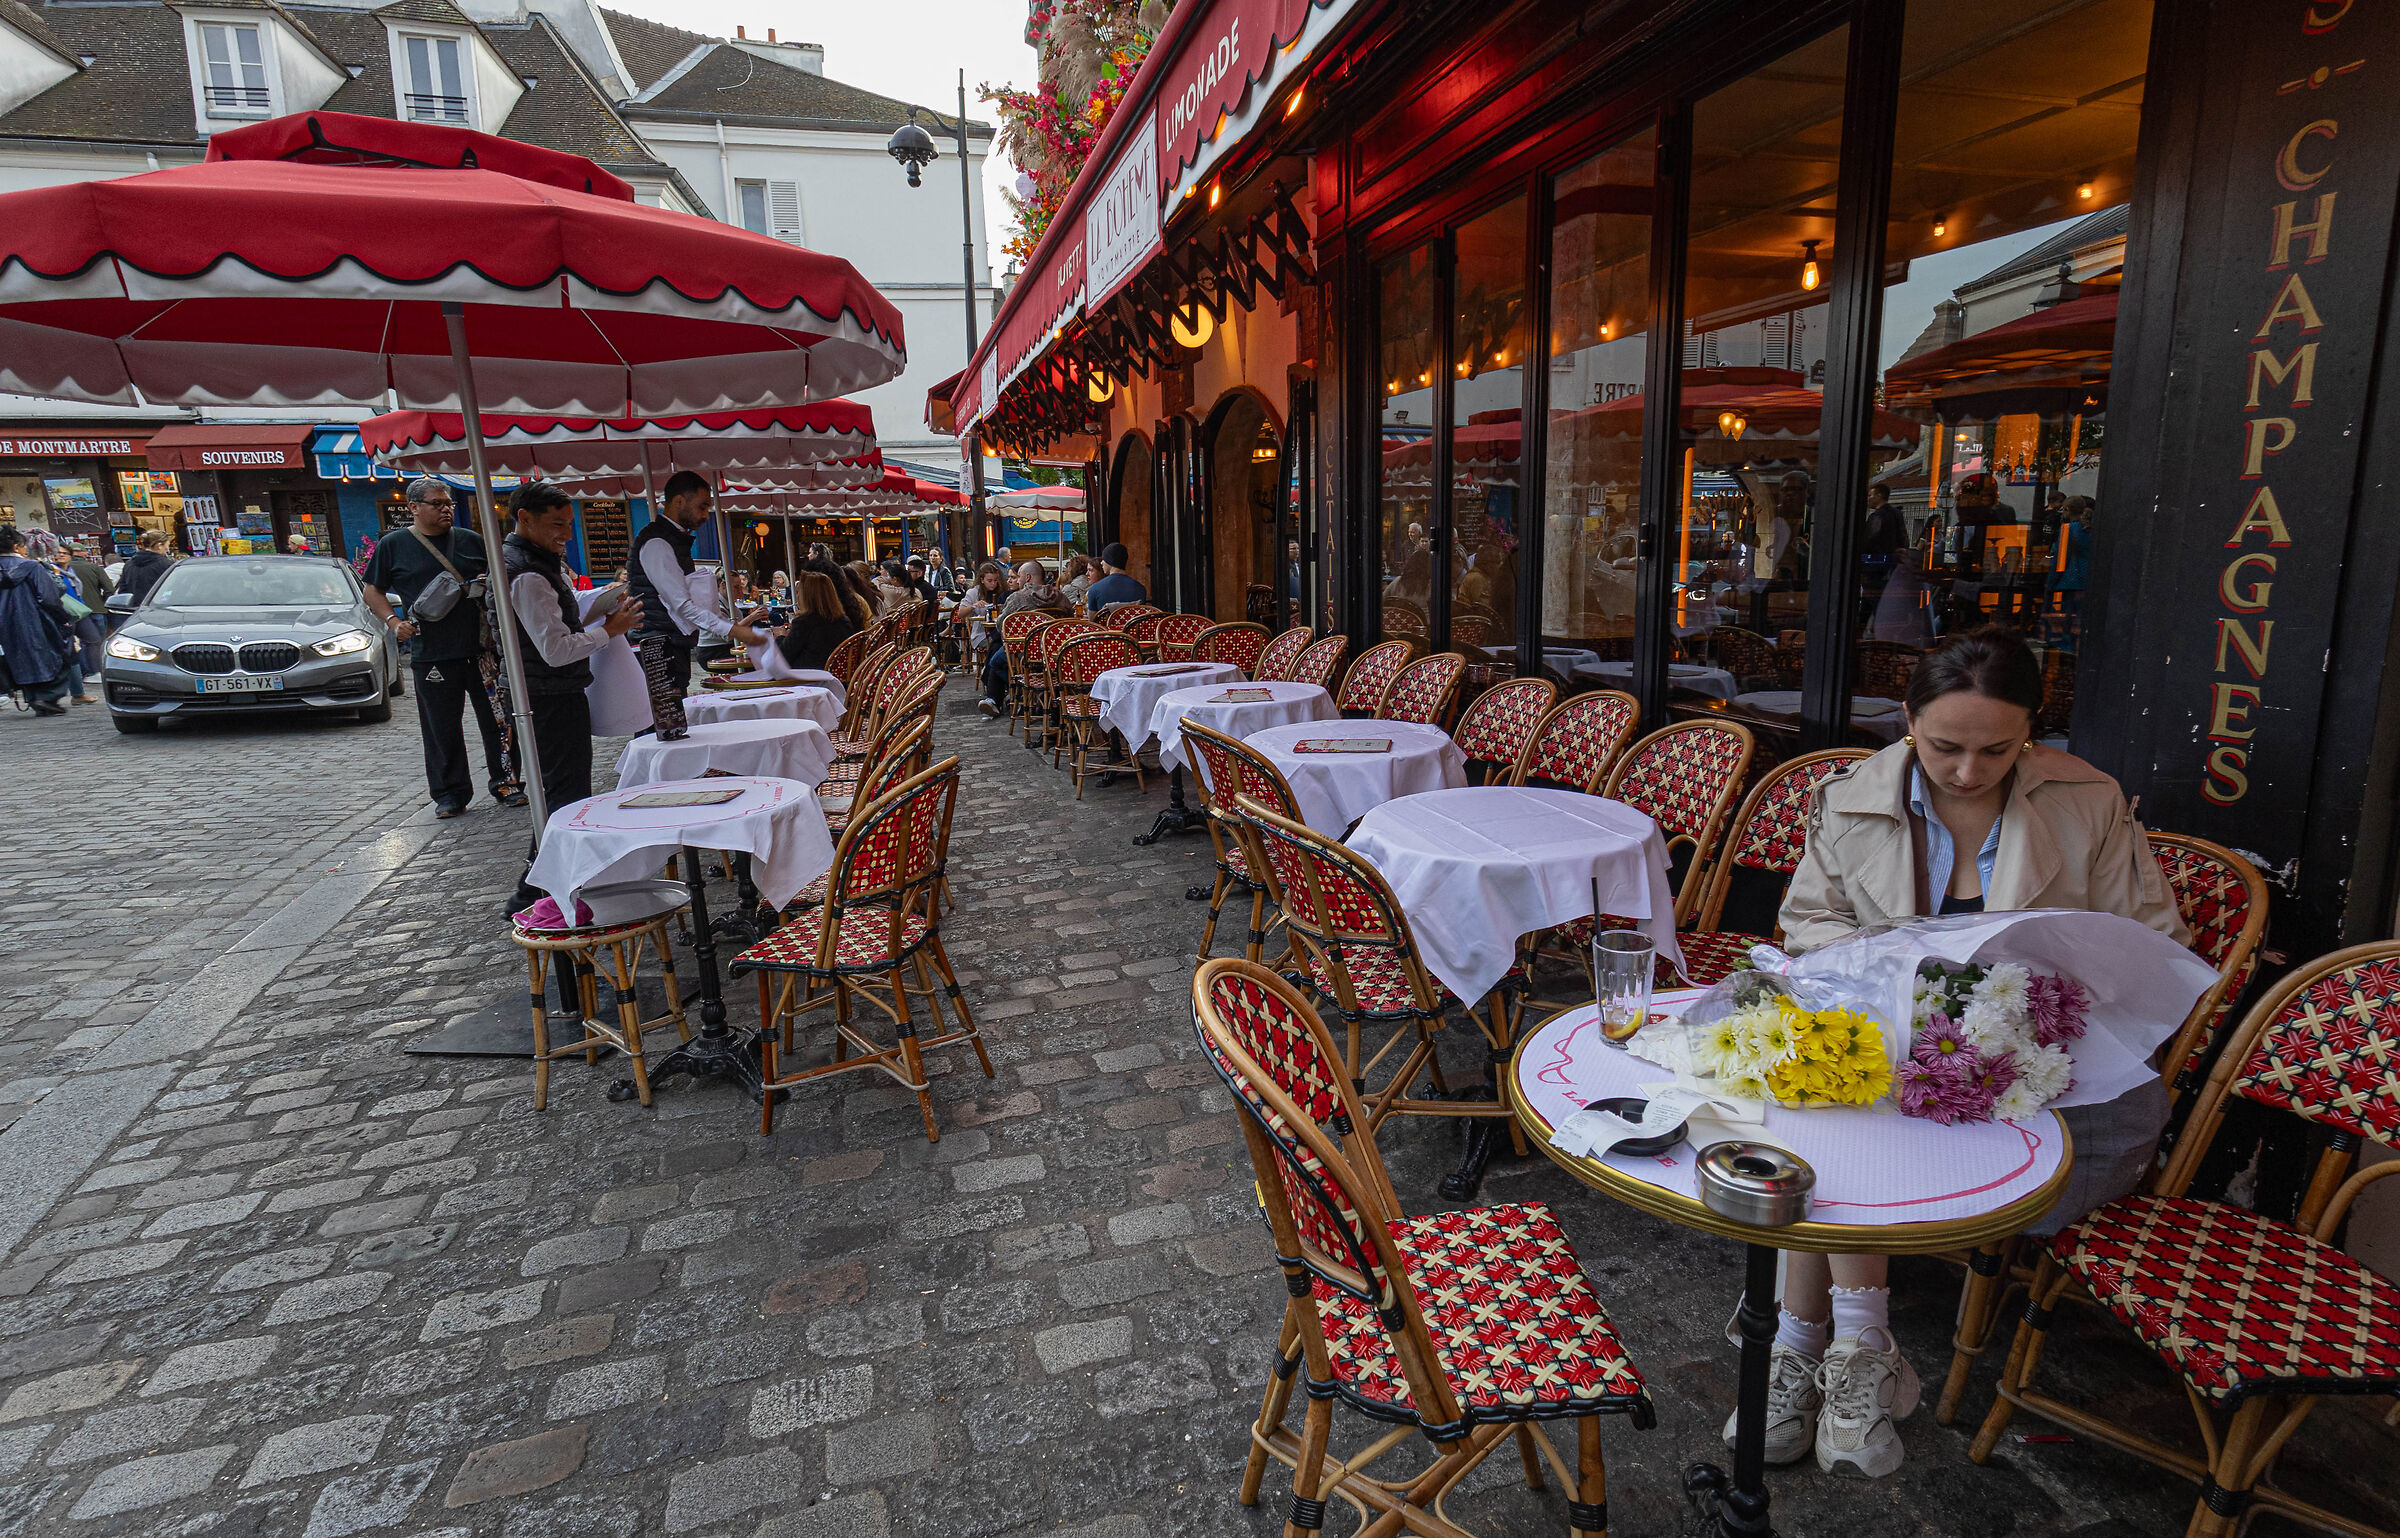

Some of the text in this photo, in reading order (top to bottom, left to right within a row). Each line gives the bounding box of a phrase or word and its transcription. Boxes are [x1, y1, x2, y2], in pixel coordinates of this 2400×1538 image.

[1165, 16, 1240, 153] LIMONADE
[1323, 280, 1335, 369] BAR
[0, 440, 131, 454] E MONTMARTRE
[202, 451, 285, 465] SOUVENIRS
[2200, 118, 2339, 807] CHAMPAGNES
[205, 677, 272, 691] GT-561-VX
